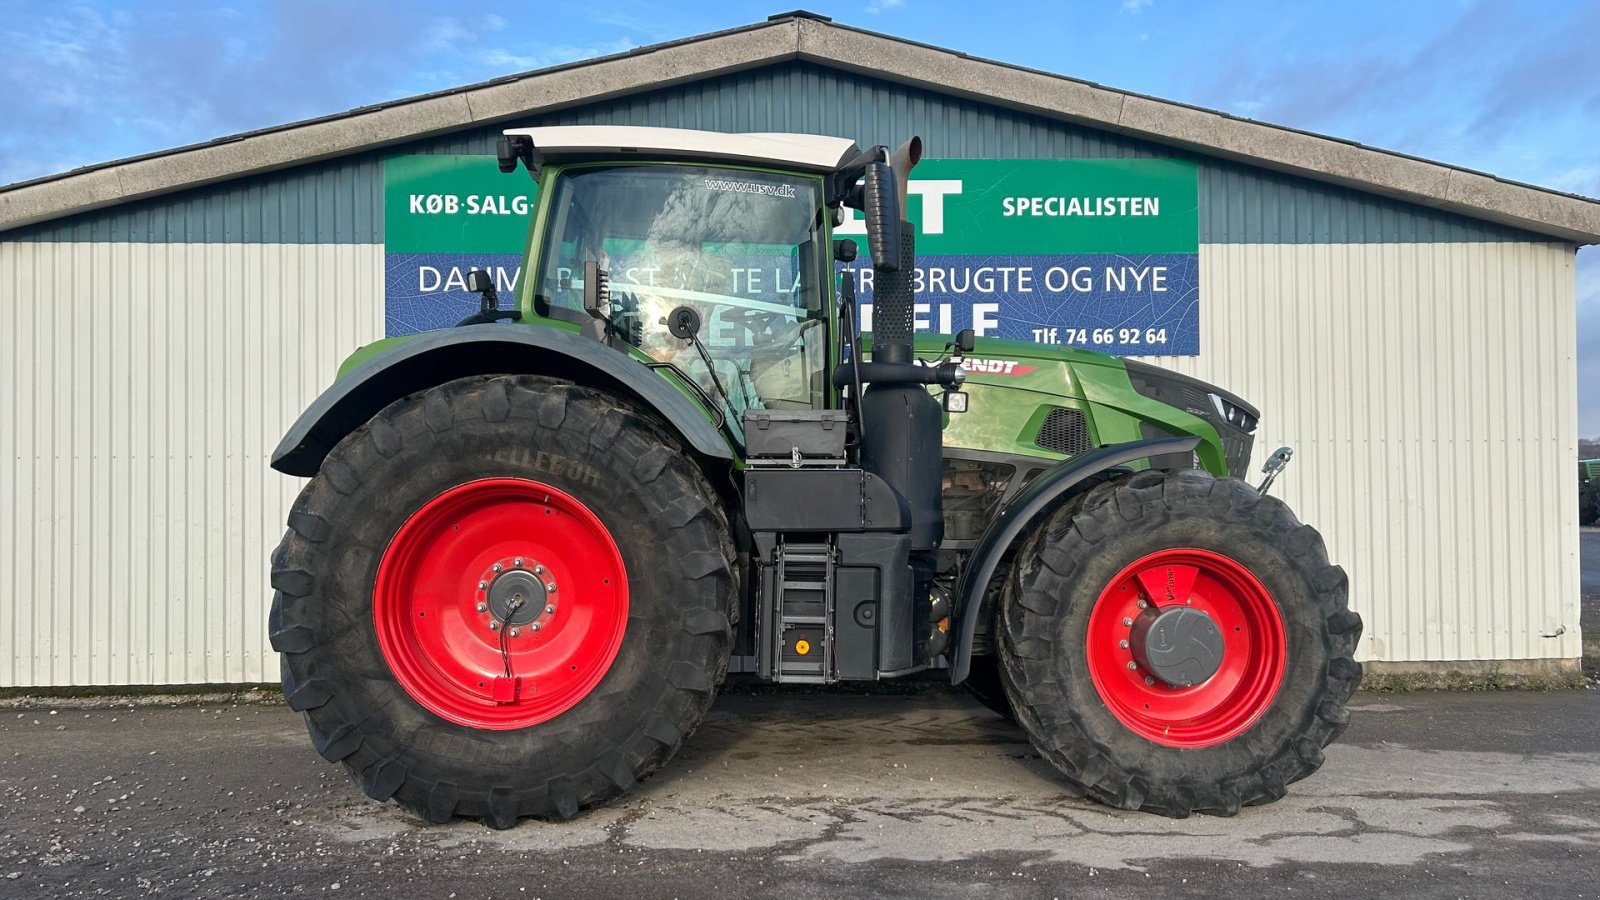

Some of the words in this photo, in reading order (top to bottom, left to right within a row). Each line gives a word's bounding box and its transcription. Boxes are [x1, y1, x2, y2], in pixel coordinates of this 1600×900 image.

[705, 180, 795, 198] www.usv.dk
[1002, 197, 1160, 216] SPECIALISTEN
[1045, 267, 1093, 293] OG
[1106, 267, 1168, 292] NYE
[1032, 328, 1061, 345] Tlf.
[1066, 328, 1088, 345] 74
[1092, 328, 1114, 345] 66
[1119, 328, 1141, 345] 92
[1145, 328, 1167, 345] 64
